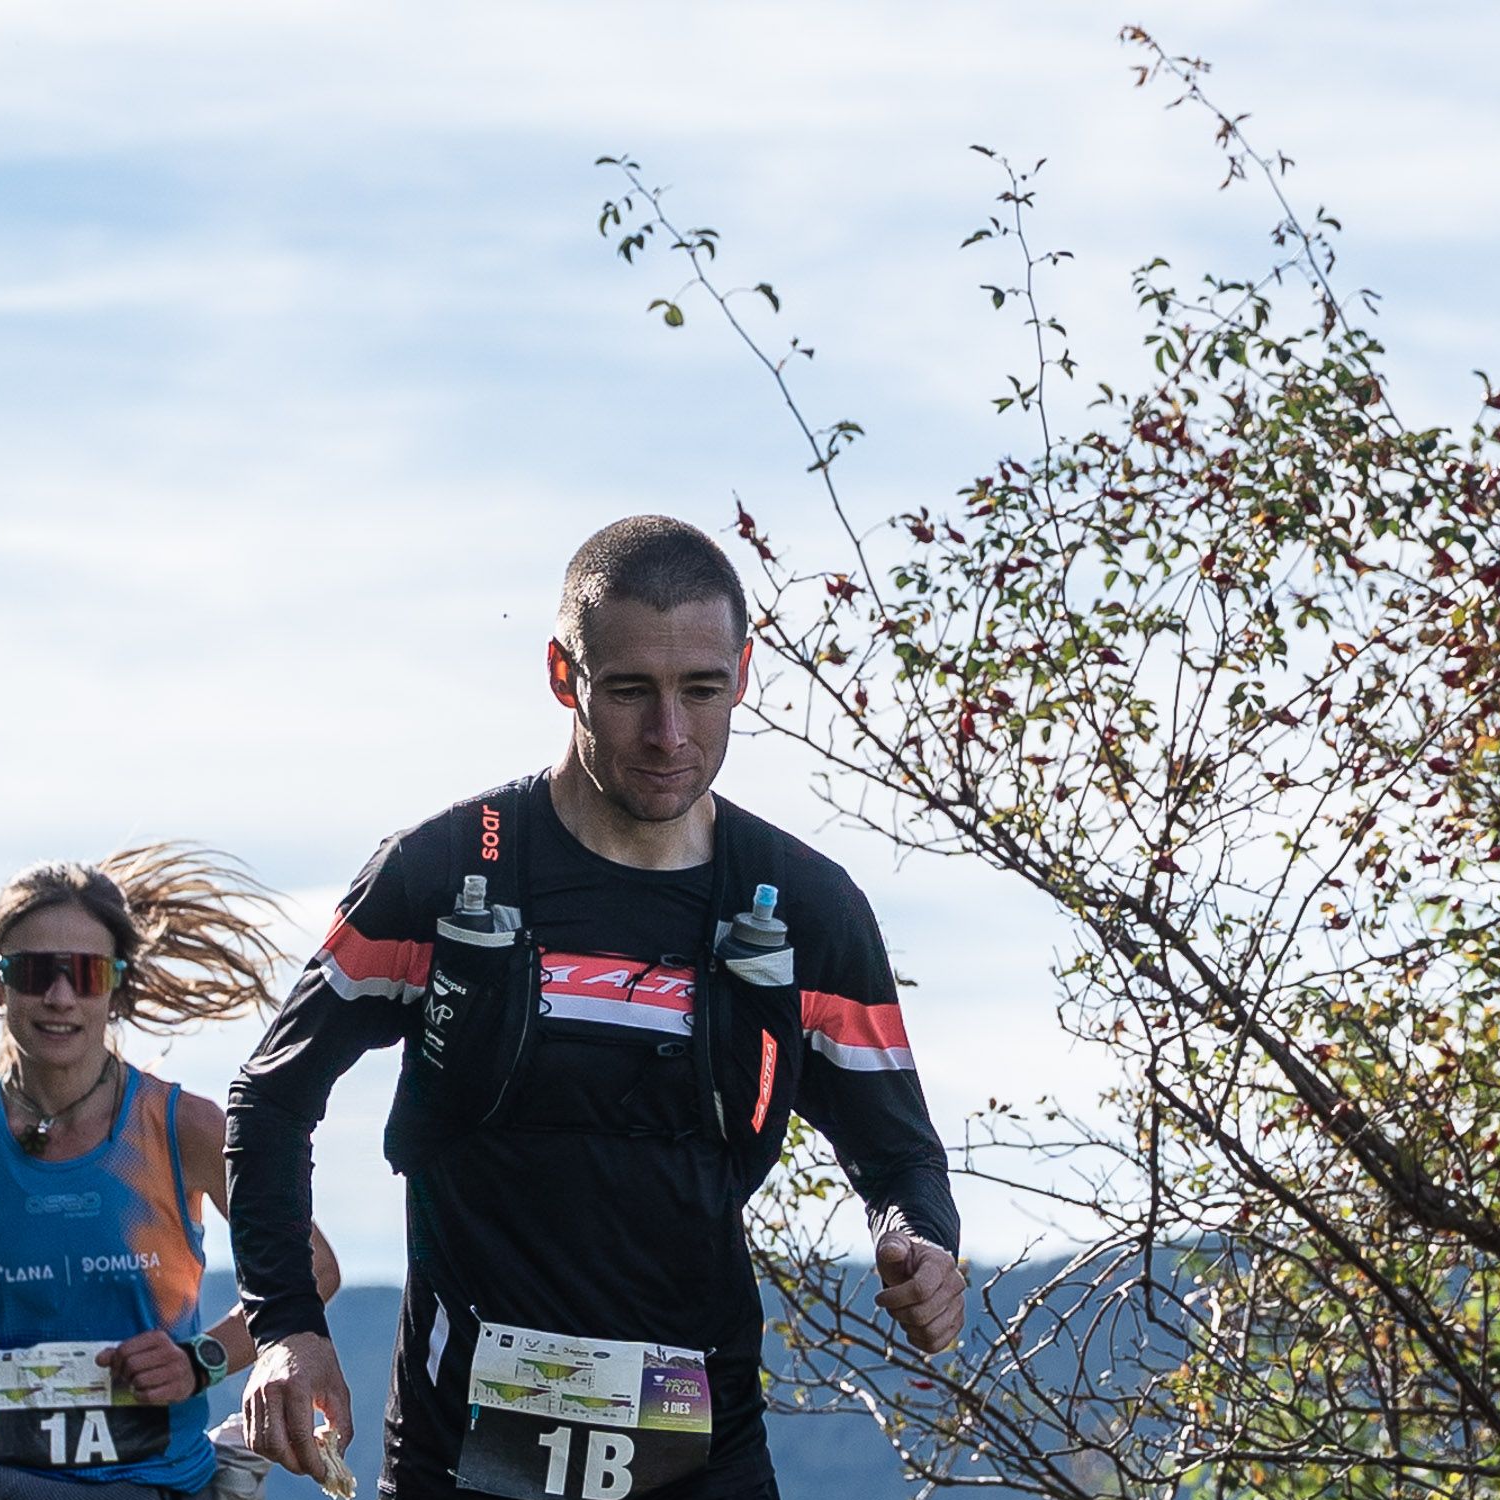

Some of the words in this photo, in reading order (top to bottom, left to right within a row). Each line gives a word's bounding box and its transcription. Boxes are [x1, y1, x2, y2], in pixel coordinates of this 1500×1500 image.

[482, 804, 499, 861] soar
[5, 1264, 54, 1283] LANA
[82, 1252, 161, 1273] DOMUSA
[665, 1384, 701, 1396] TRAIL
[662, 1401, 669, 1413] 3
[670, 1402, 691, 1415] DIES
[40, 1410, 119, 1464] 1A
